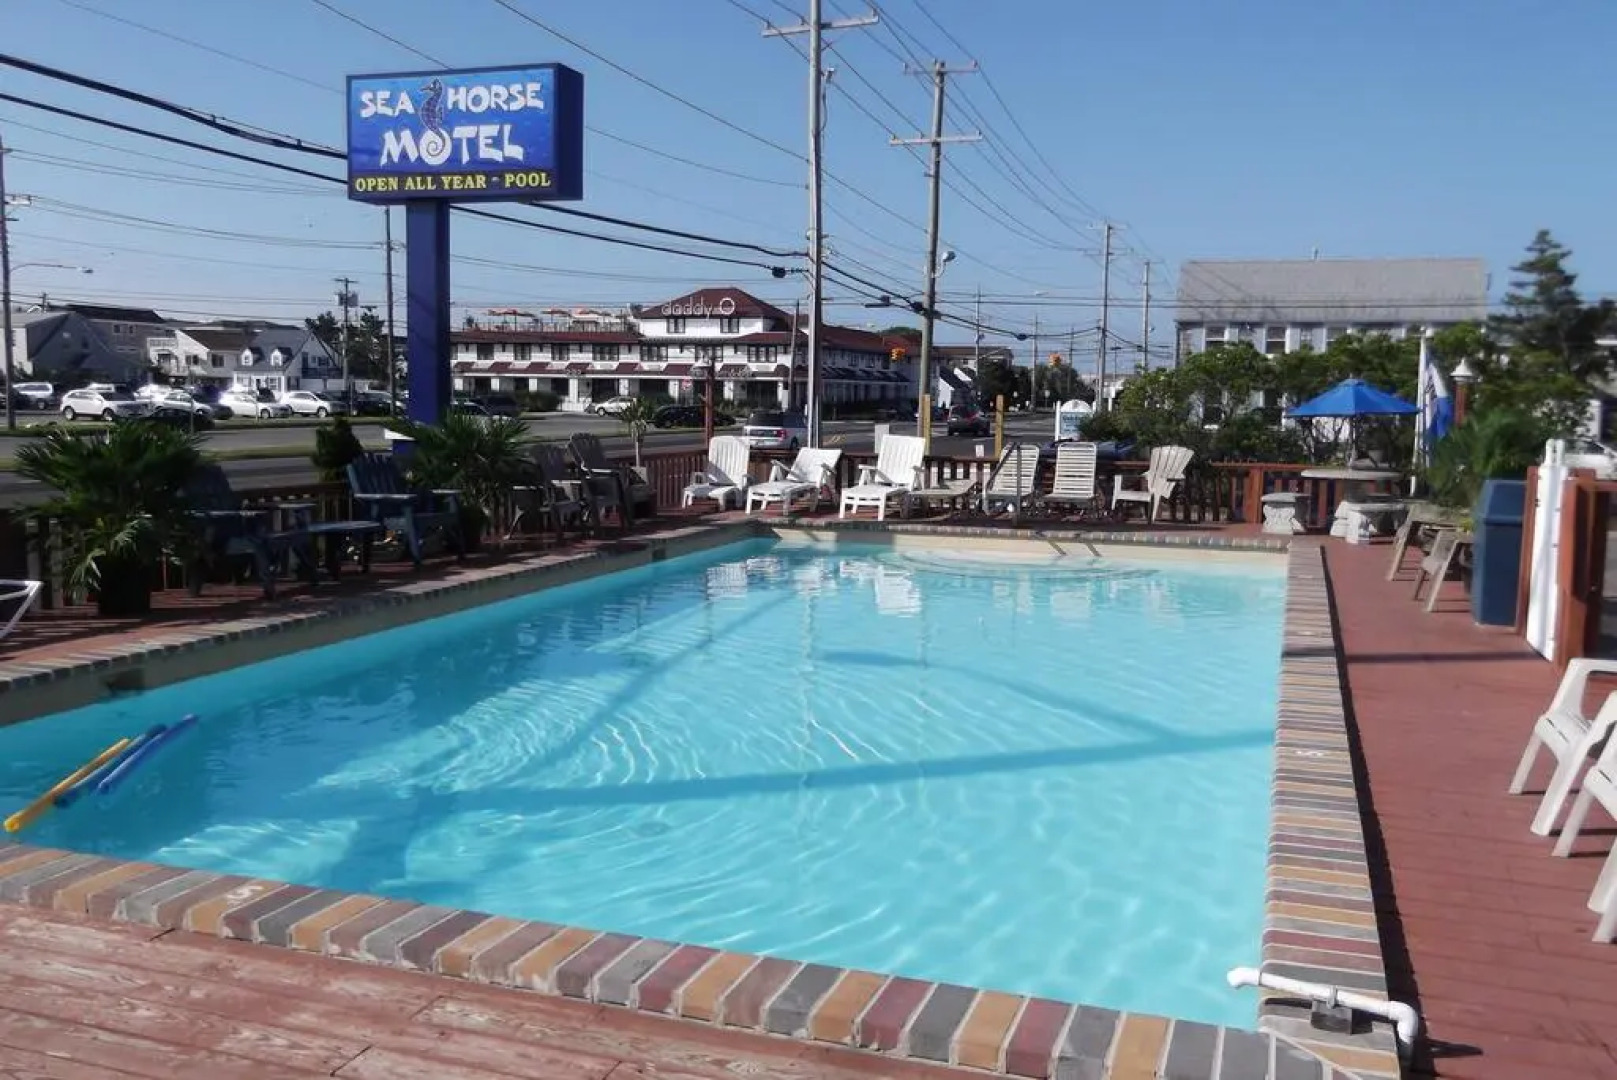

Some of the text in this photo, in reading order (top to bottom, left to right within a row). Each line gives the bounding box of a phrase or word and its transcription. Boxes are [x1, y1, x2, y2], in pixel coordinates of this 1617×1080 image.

[360, 82, 544, 118] SEA HORSE
[379, 124, 524, 167] MOTEL
[355, 176, 399, 192] OPEN
[405, 176, 437, 191] ALL
[441, 174, 487, 190] YEAR
[504, 172, 551, 188] POOL
[661, 296, 735, 320] daddy O
